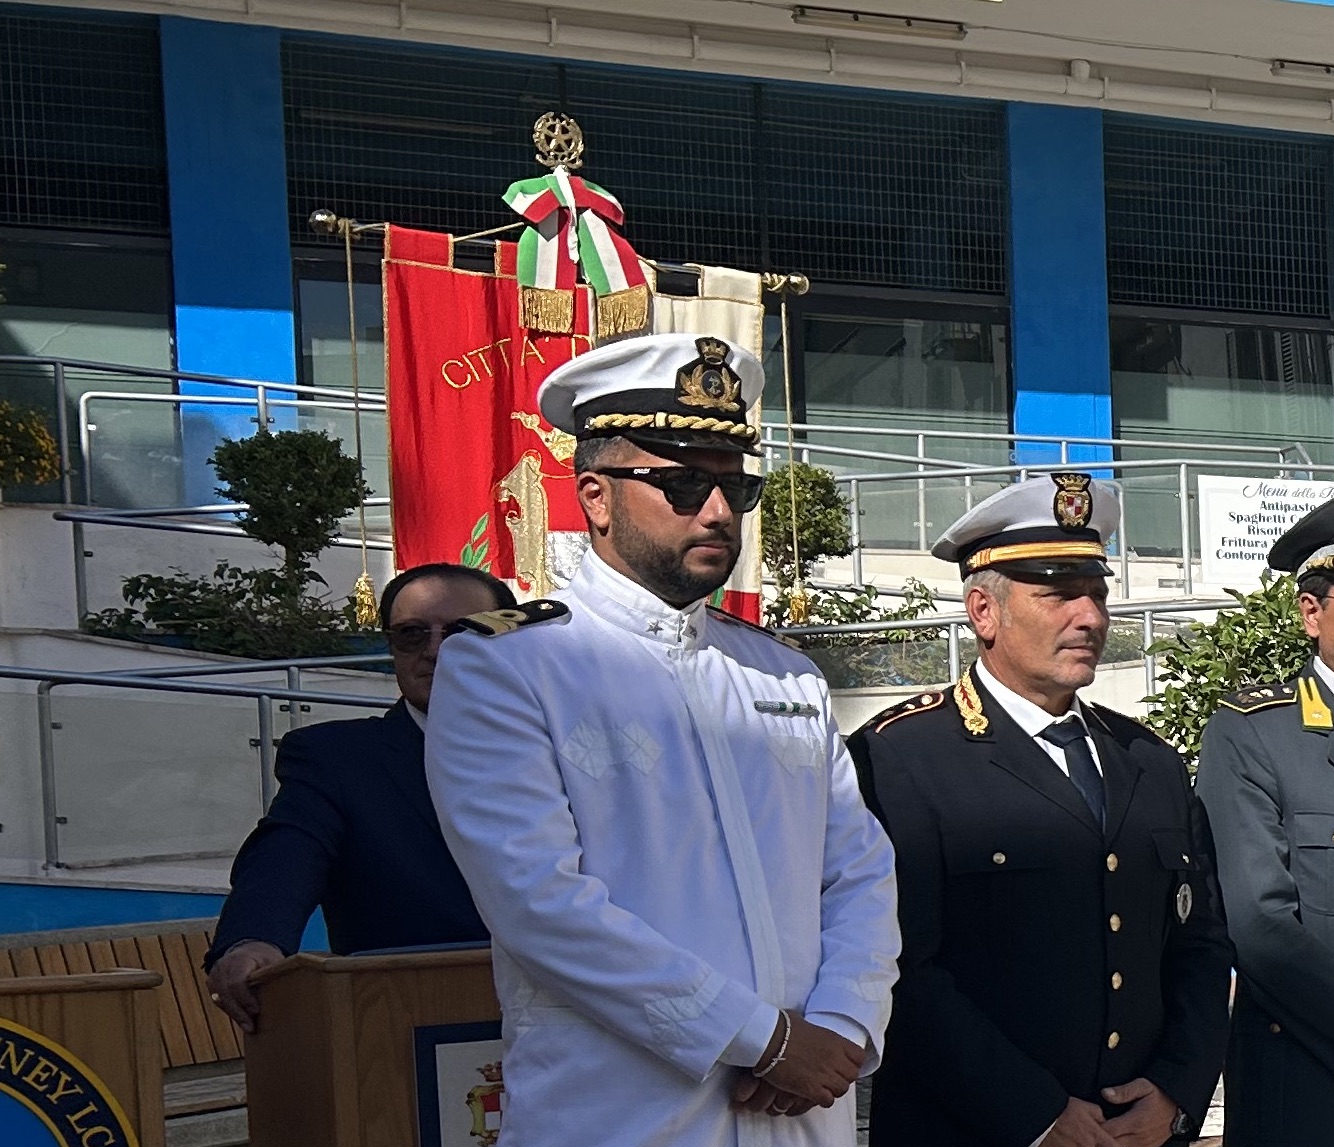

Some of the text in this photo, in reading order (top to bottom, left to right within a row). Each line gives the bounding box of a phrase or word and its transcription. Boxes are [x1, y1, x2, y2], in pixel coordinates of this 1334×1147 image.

[1260, 500, 1317, 514] Antipasto
[1228, 512, 1286, 525] Spaghetti
[1222, 536, 1268, 549] Frittura
